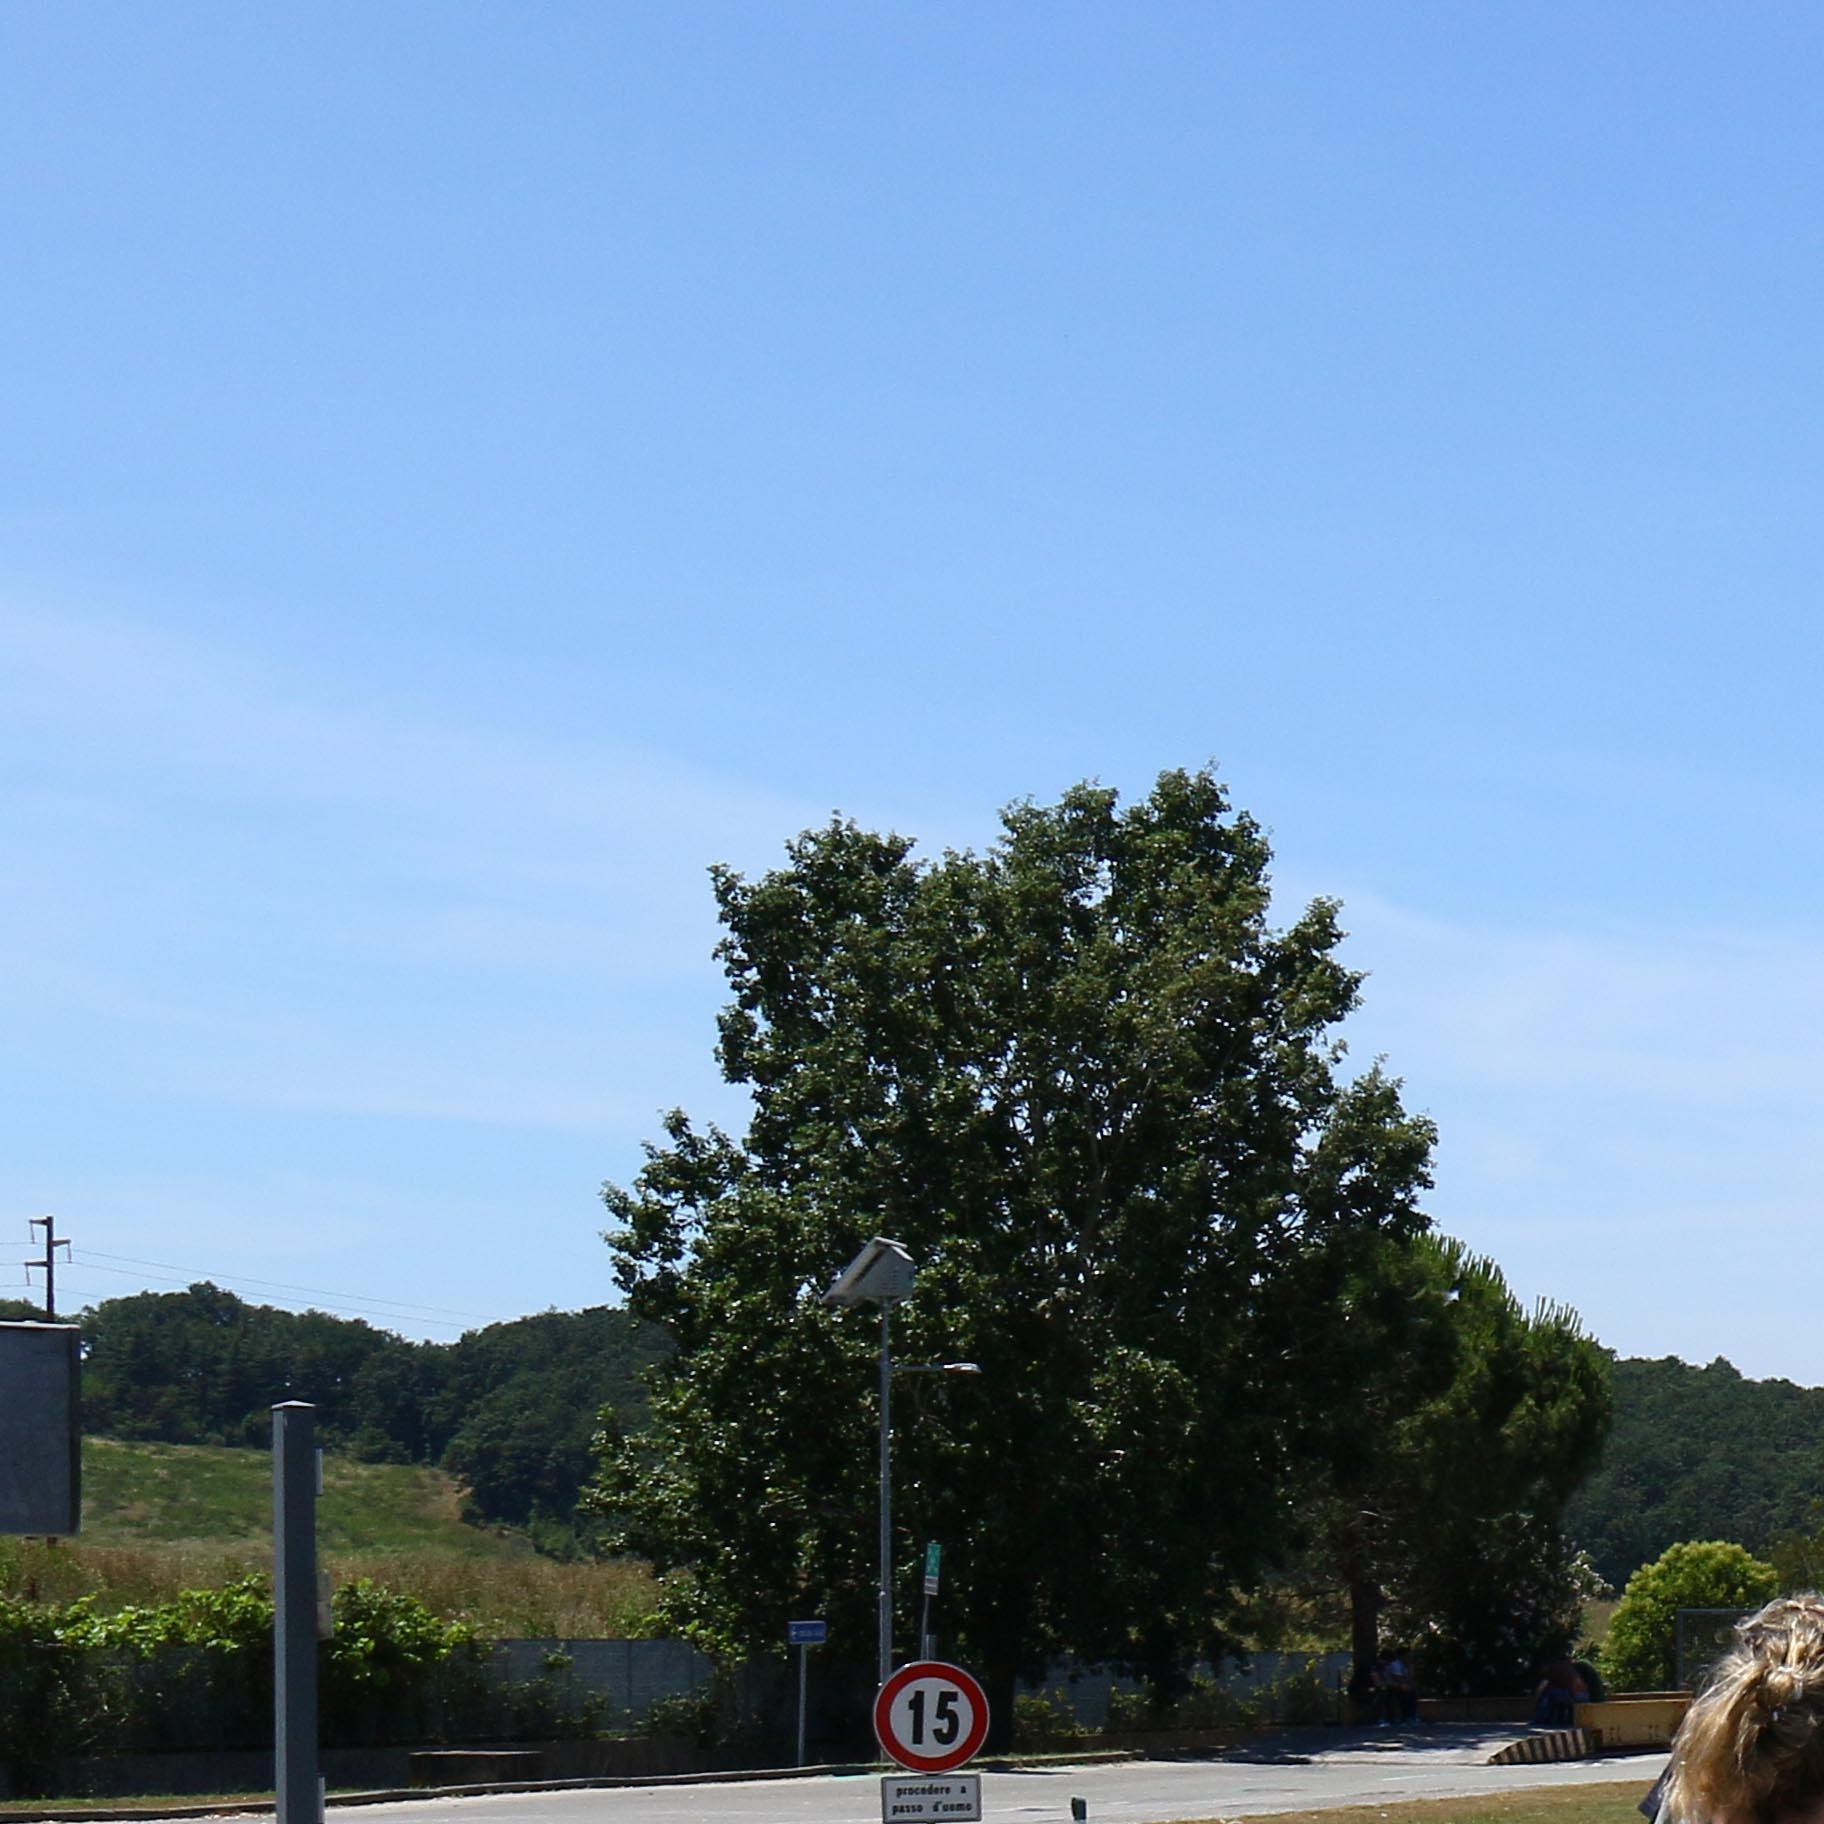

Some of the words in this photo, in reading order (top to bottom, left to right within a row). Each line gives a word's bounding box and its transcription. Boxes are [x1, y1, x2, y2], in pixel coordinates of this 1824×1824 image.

[907, 1690, 960, 1746] 15
[895, 1783, 951, 1799] procedere
[960, 1785, 967, 1794] a
[892, 1803, 924, 1816] passo
